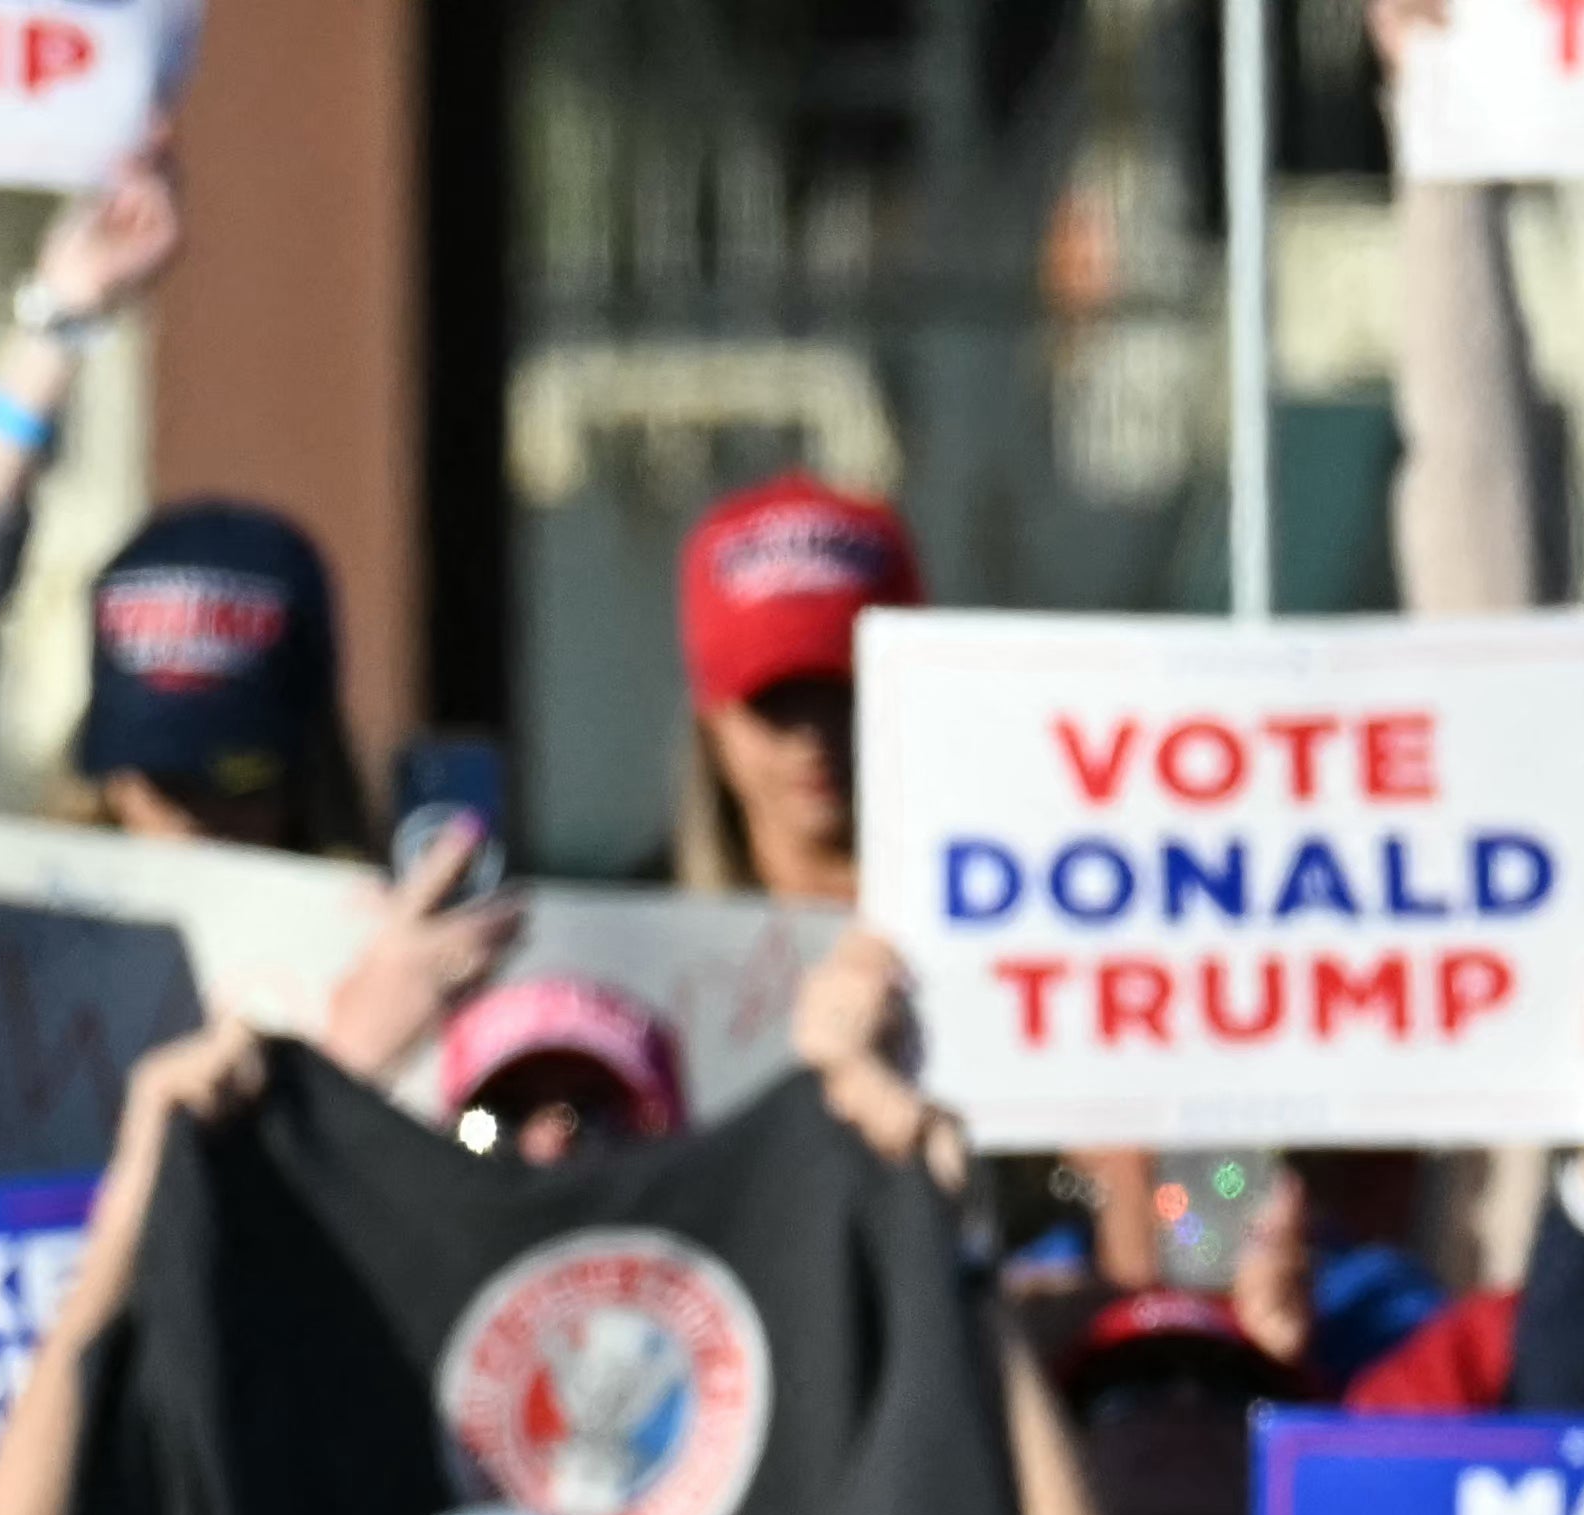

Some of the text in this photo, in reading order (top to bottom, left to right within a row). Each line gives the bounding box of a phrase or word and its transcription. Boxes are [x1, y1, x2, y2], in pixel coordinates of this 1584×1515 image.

[1052, 712, 1436, 808] VOTE
[939, 832, 1556, 930] DONALD
[994, 948, 1516, 1048] TRUMP
